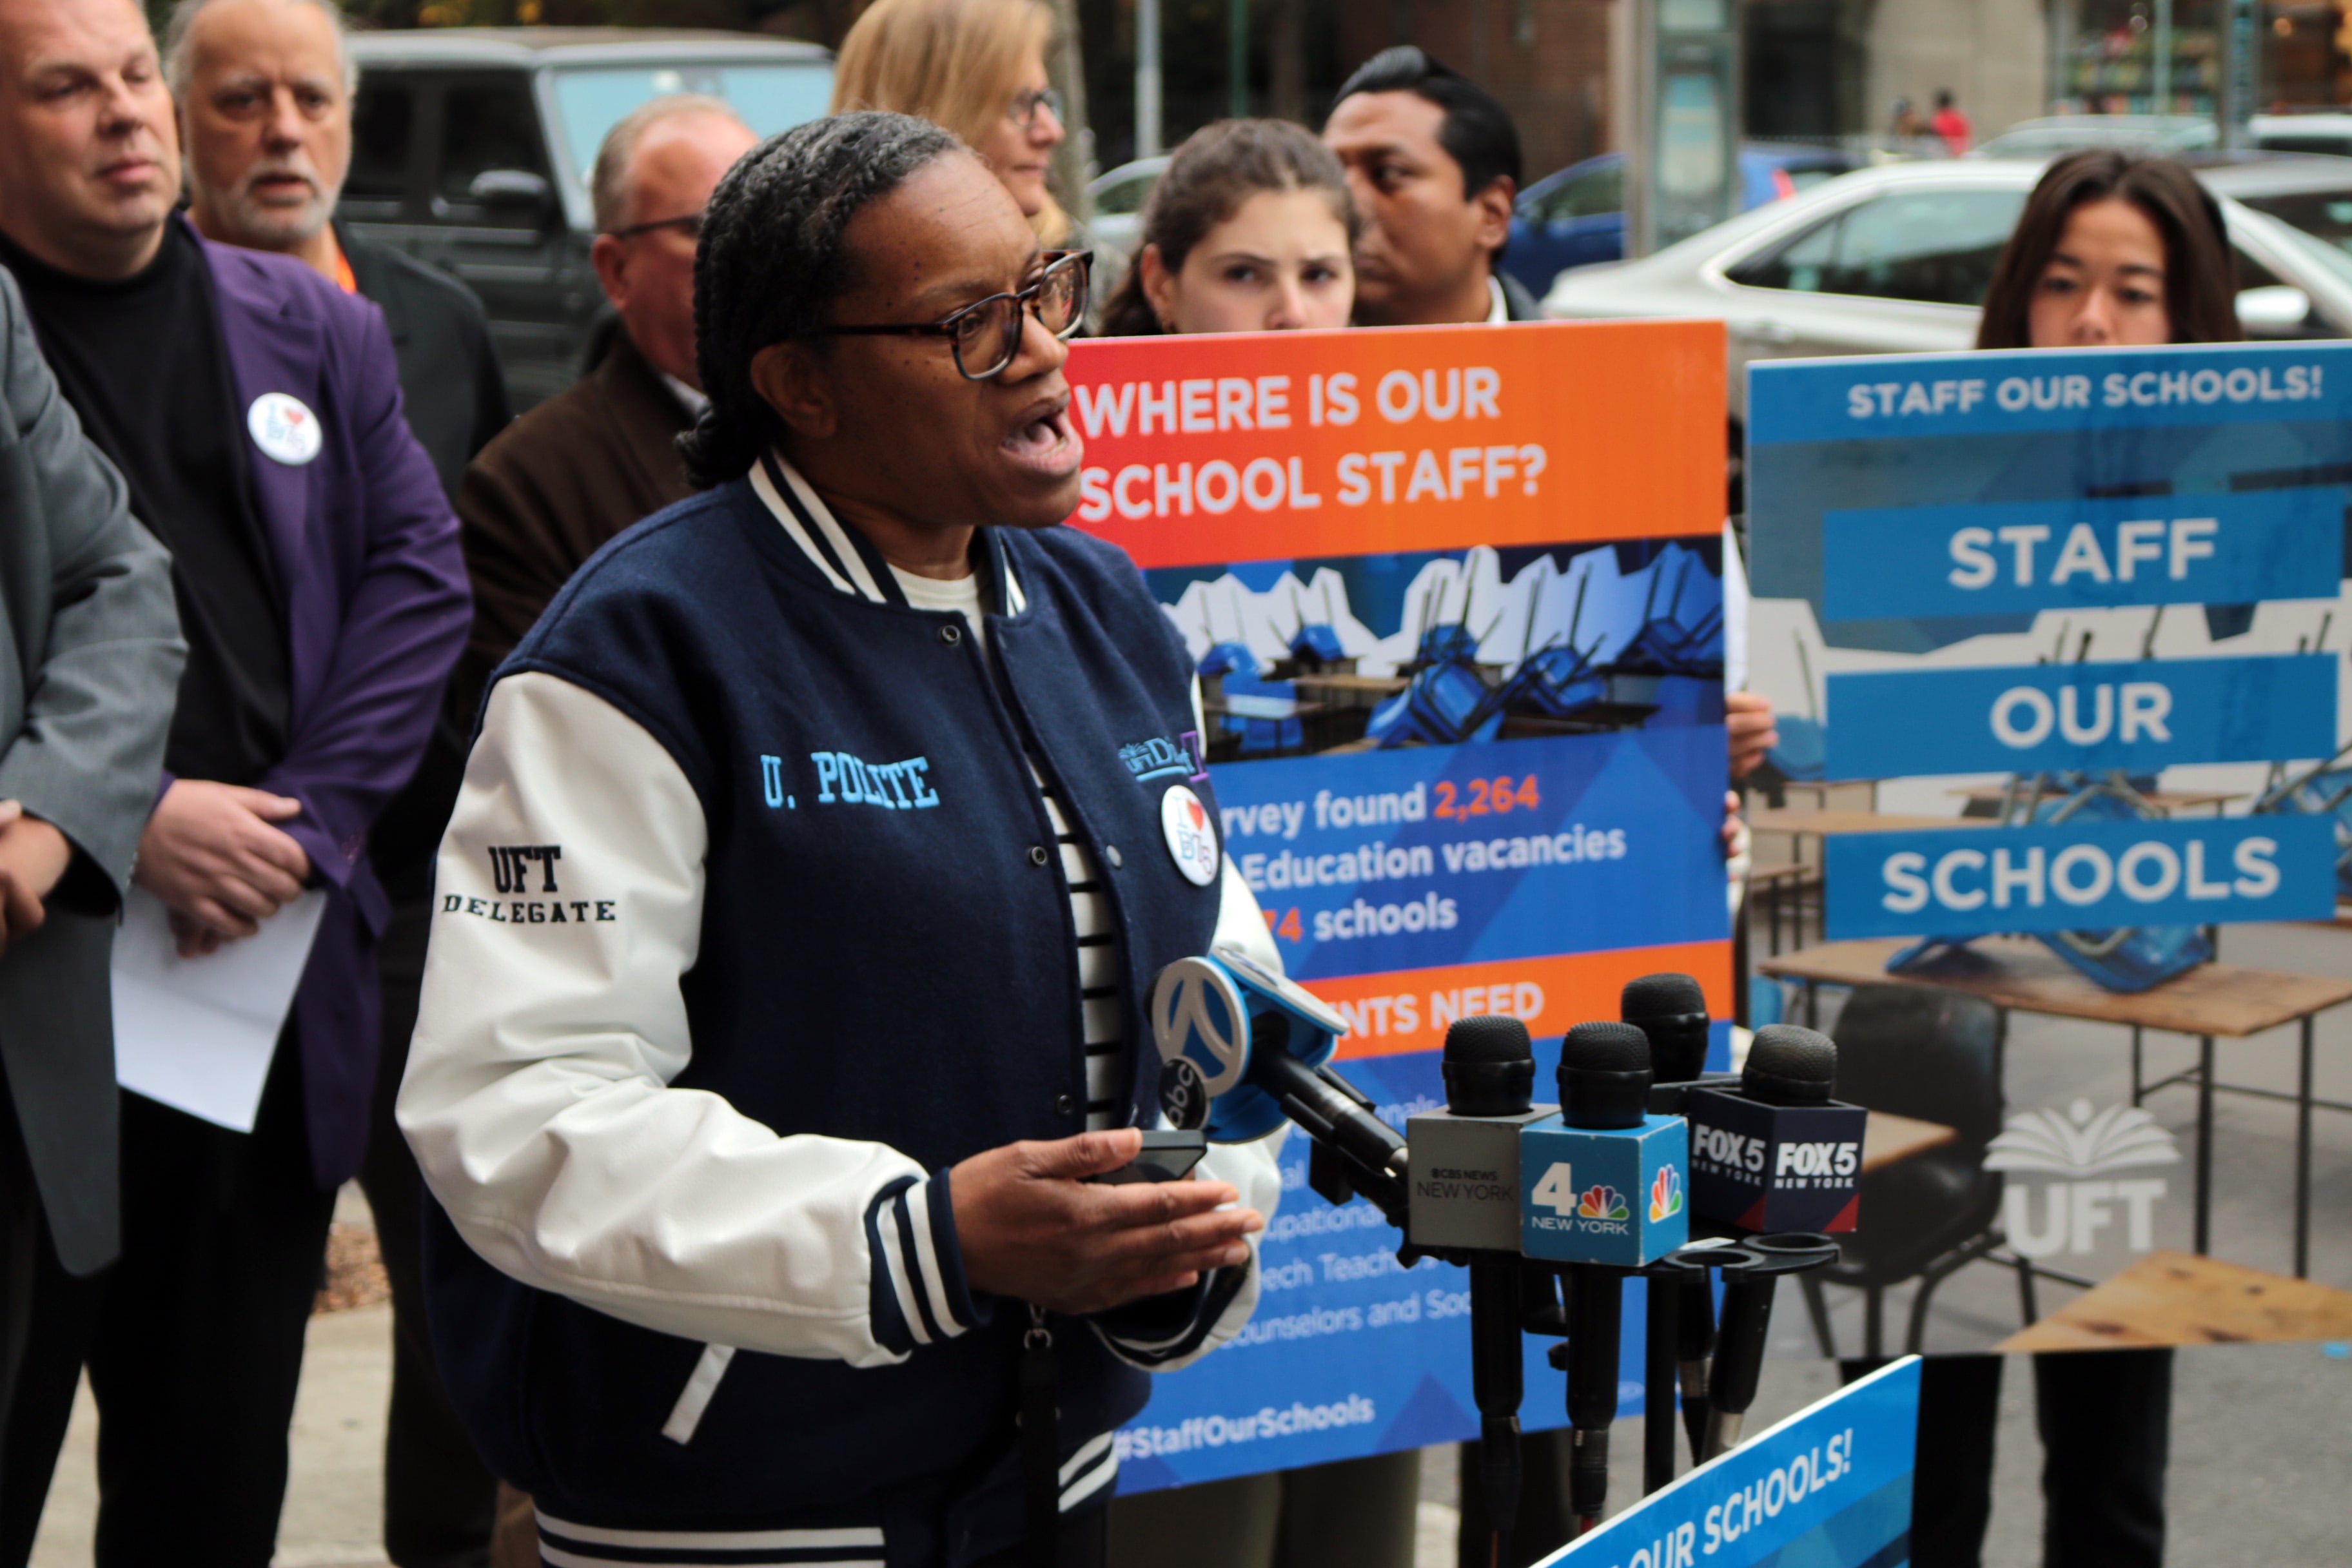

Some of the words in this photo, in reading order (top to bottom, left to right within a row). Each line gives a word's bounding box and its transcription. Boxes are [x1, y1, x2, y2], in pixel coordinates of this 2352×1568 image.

[1075, 375, 1290, 438] WHERE
[1309, 372, 1359, 426] IS
[1376, 366, 1501, 424] OUR
[1847, 378, 1986, 418] STAFF
[1995, 375, 2091, 411] OUR
[2103, 365, 2324, 407] SCHOOLS!
[1079, 456, 1321, 522] SCHOOL
[1337, 444, 1547, 505] STAFF?
[1948, 518, 2219, 589] STAFF
[1990, 682, 2173, 749] OUR
[761, 754, 794, 810] U.
[811, 750, 940, 810] POLITE
[1220, 801, 1305, 839] rvey
[1313, 781, 1427, 829] found
[1434, 774, 1540, 823] 2,264
[488, 845, 561, 894] UFT
[1241, 841, 1433, 892] Education
[1443, 823, 1627, 873] vacancies
[1882, 837, 2280, 914] SCHOOLS
[442, 894, 616, 923] DELEGATE
[1263, 907, 1303, 942] 74
[1313, 891, 1458, 942] schools
[1430, 981, 1545, 1030] NEED
[1416, 1181, 1460, 1199] NEW
[1463, 1184, 1514, 1202] YORK
[1440, 1168, 1462, 1179] CBS
[1464, 1170, 1498, 1181] NEWS
[1532, 1162, 1577, 1216] 4
[1691, 1158, 1720, 1175] NEW
[1725, 1168, 1762, 1186] YORK
[1774, 1178, 1807, 1188] NEW
[1813, 1178, 1854, 1188] YORK
[1532, 1217, 1573, 1231] NEW
[1576, 1219, 1629, 1235] YORK
[2003, 1178, 2168, 1259] UFT
[1318, 1246, 1438, 1282] Teachs
[1367, 1291, 1420, 1328] and
[1426, 1289, 1471, 1319] Soc
[1113, 1393, 1375, 1461] #StaffOurSchools
[1702, 1427, 1853, 1554] SCHOOLS!
